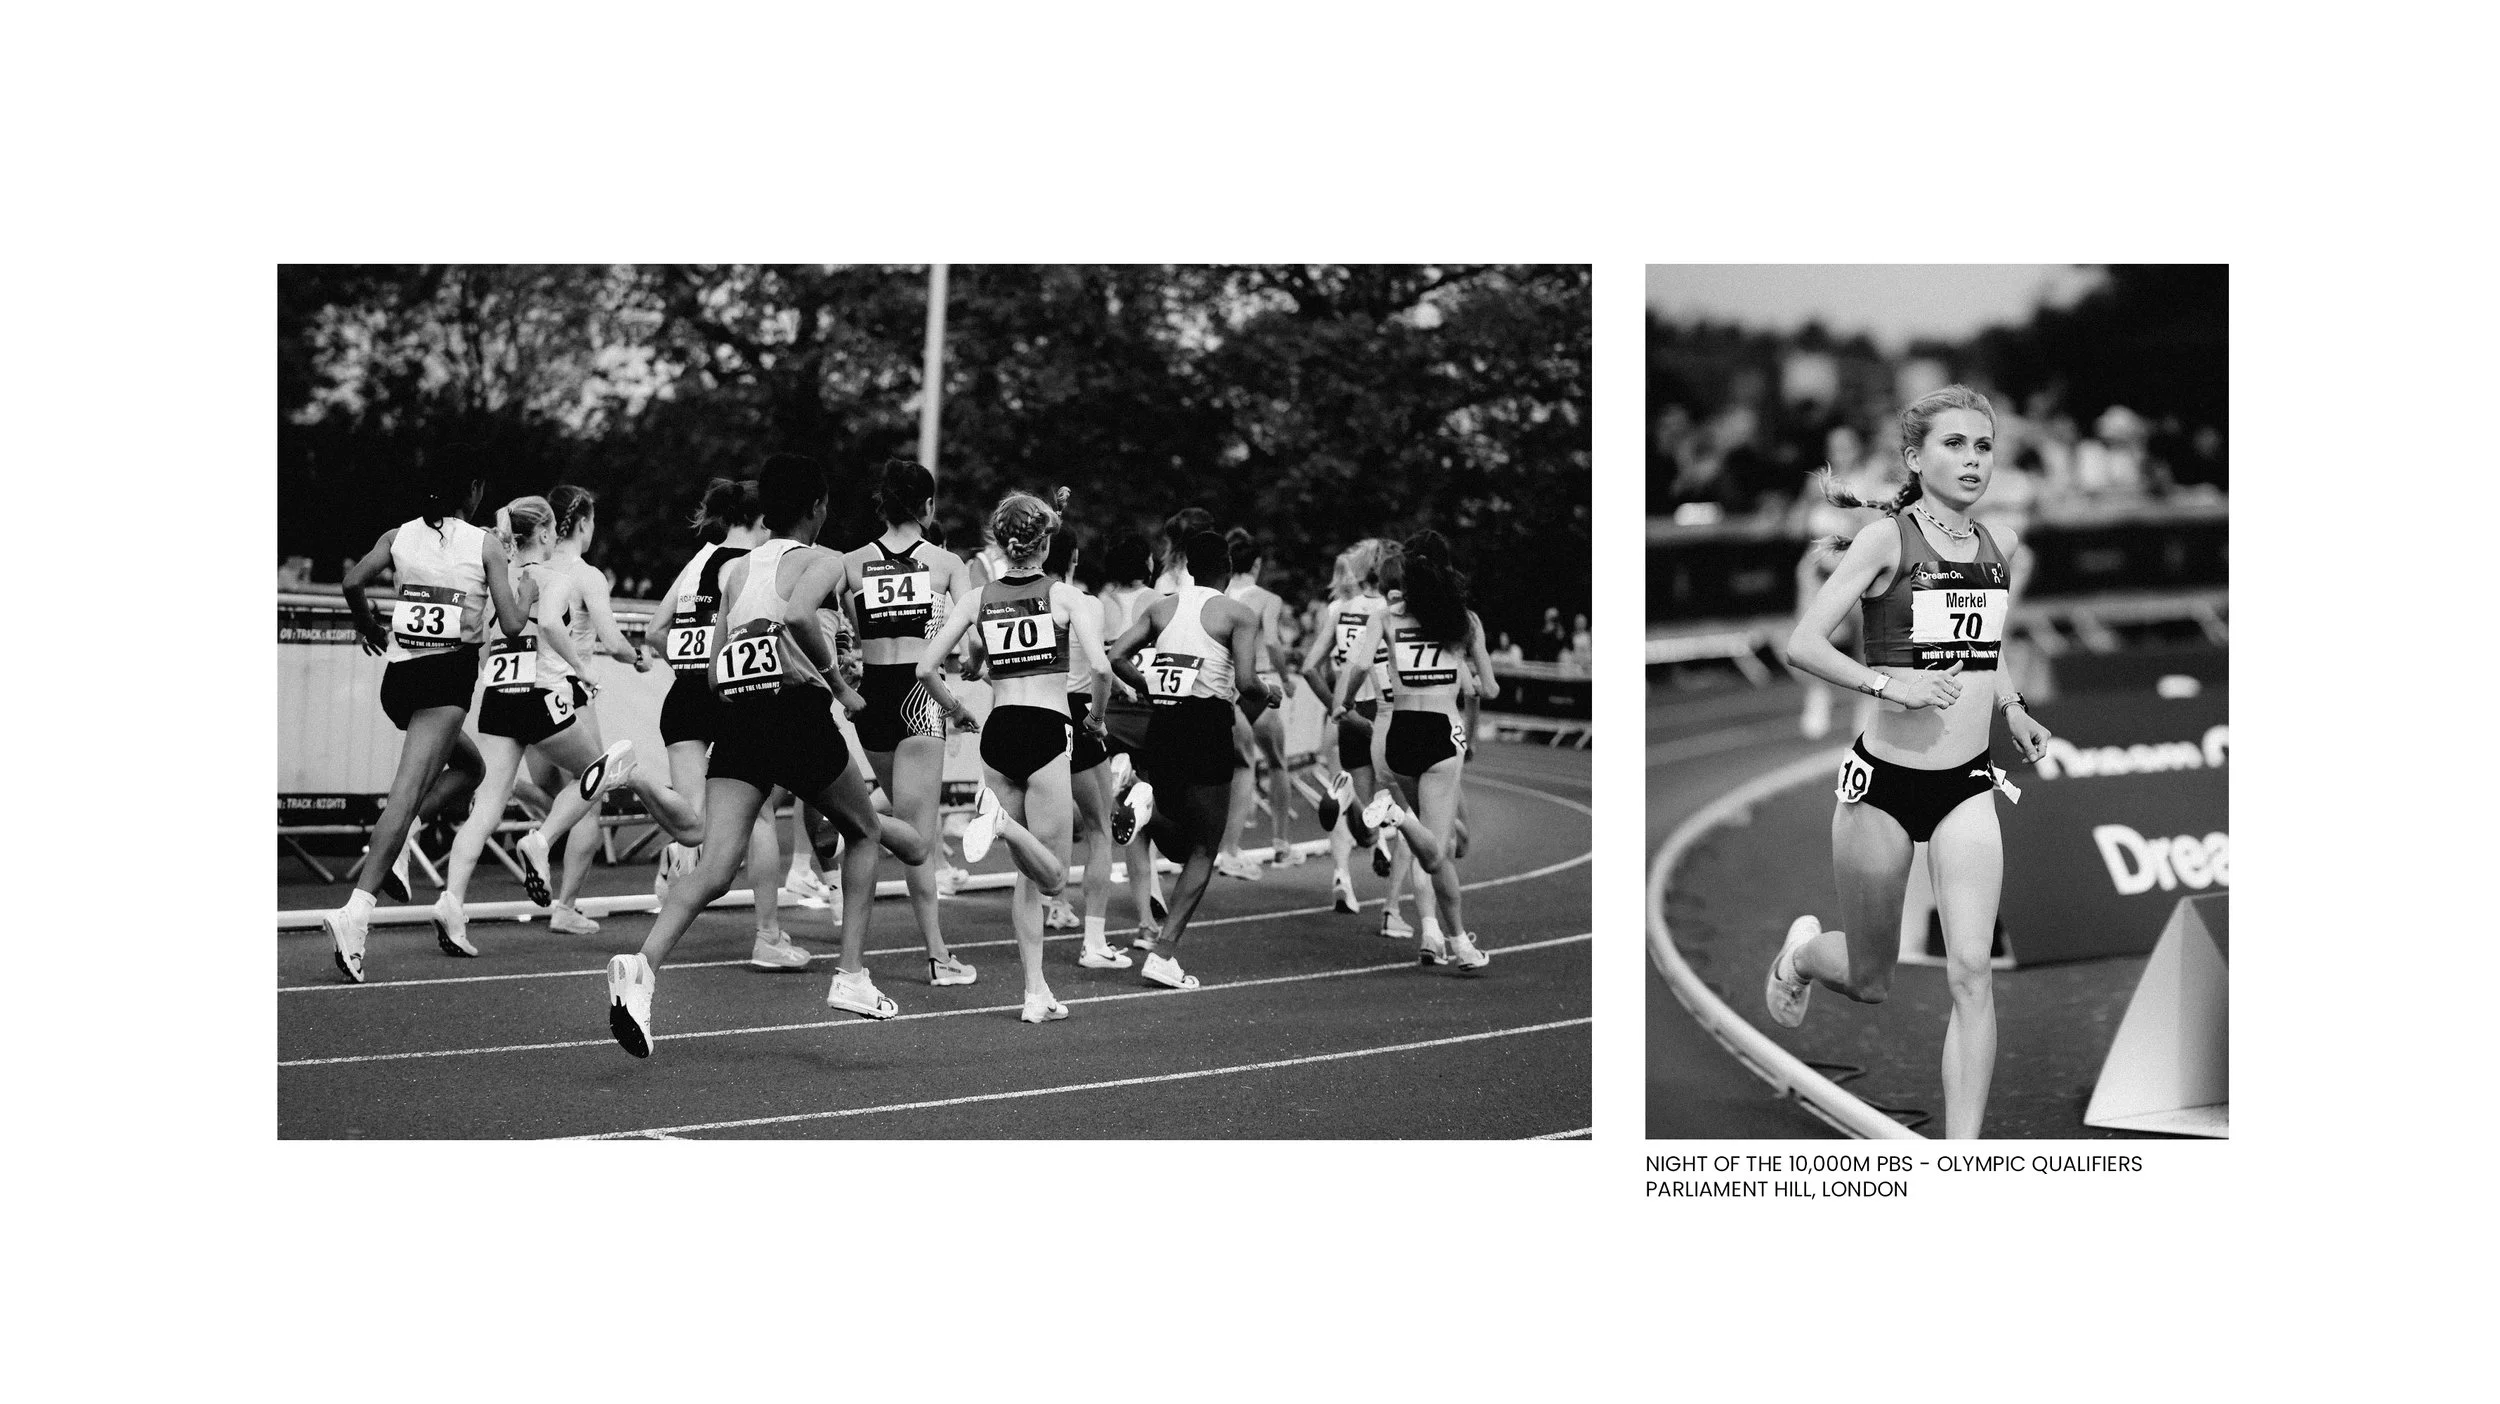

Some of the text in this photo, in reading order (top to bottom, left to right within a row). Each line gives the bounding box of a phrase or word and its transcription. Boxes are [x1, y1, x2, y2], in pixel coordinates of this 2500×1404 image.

[1921, 570, 1964, 580] Dream On.
[878, 576, 915, 604] 54
[1946, 592, 1986, 608] Merkel
[407, 605, 445, 635] 33
[1950, 613, 1982, 639] 70
[678, 629, 705, 656] 28
[997, 619, 1038, 650] 70
[723, 639, 776, 678] 123
[1409, 643, 1442, 668] 77
[1922, 651, 1944, 659] NIGHT
[1945, 651, 1955, 659] OF
[1956, 650, 1970, 658] THE
[493, 655, 519, 682] 21
[1156, 669, 1183, 694] 75
[1841, 760, 1867, 799] 19
